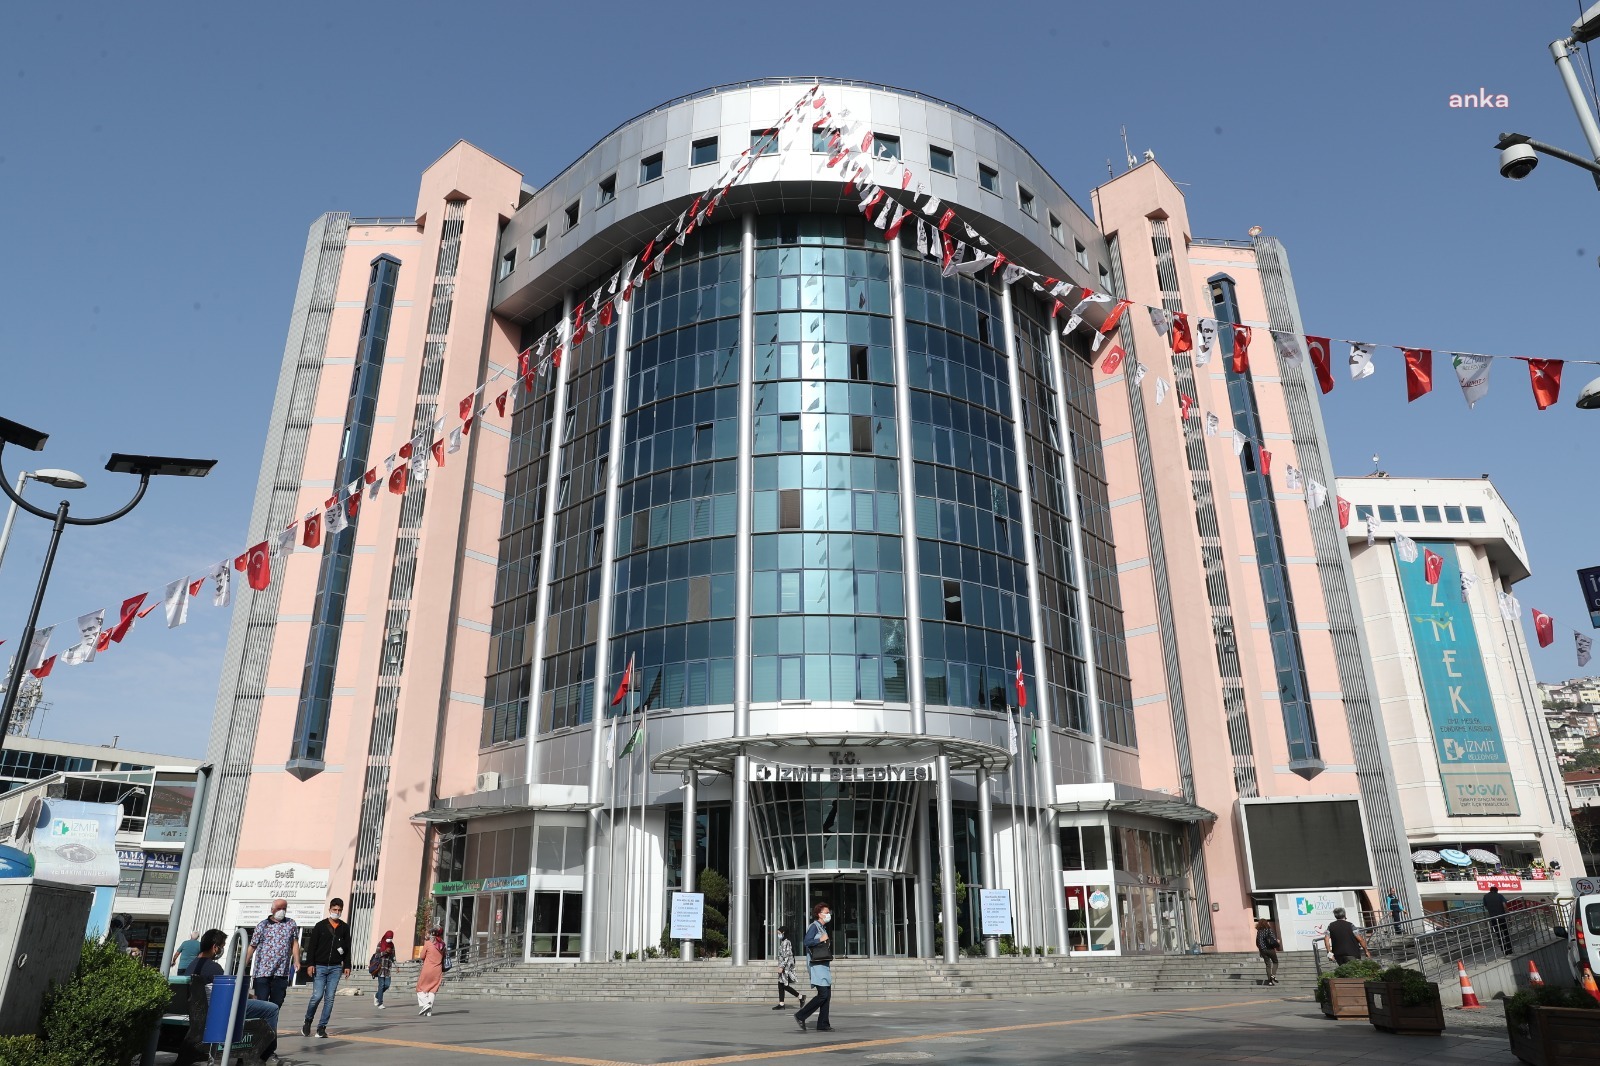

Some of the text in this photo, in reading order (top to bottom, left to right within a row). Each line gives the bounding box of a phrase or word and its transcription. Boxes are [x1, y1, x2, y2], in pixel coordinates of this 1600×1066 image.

[1464, 739, 1494, 752] İZMİT
[829, 751, 861, 765] T.C.
[775, 764, 933, 782] İZMİT BELEDİYESİ
[153, 852, 176, 862] YAPI
